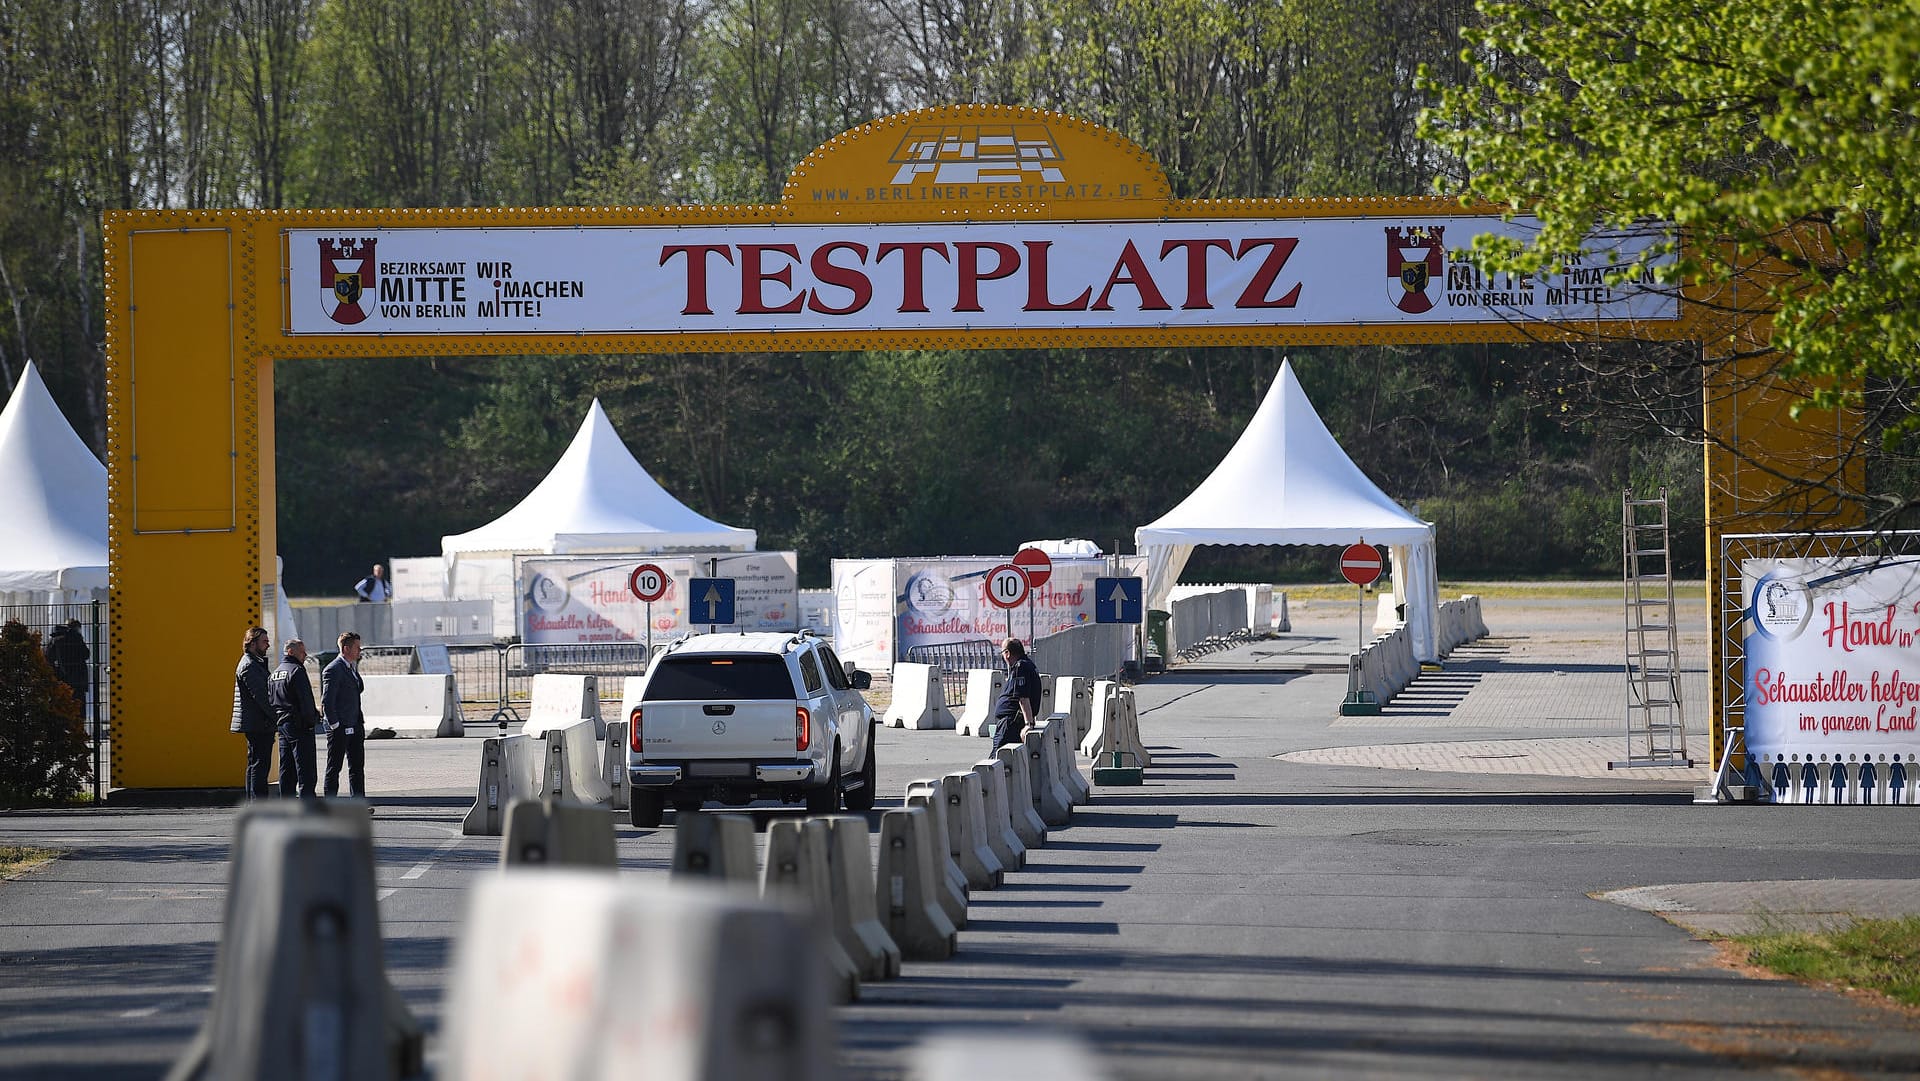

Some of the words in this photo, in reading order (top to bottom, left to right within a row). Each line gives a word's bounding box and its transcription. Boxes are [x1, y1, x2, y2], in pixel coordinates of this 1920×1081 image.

[812, 184, 1143, 200] WWW.BERLINER-FESTPLATZ.DE
[380, 262, 466, 275] BEZIRKSAMT
[477, 262, 512, 279] WIR
[659, 238, 1303, 315] TESTPLATZ
[380, 277, 466, 303] MITTE
[503, 281, 584, 298] MACHEN
[1447, 293, 1478, 307] VON
[1483, 292, 1534, 307] BERLIN
[380, 305, 411, 318] VON
[415, 304, 466, 318] BERLIN
[641, 576, 657, 590] 10
[997, 576, 1018, 597] 10
[1037, 580, 1085, 609] Hand
[903, 616, 972, 636] Schausteller
[974, 616, 1006, 636] helfen
[1823, 601, 1898, 653] Hand
[1899, 629, 1914, 648] in
[1755, 668, 1868, 706] Schausteller
[1799, 713, 1818, 731] im
[1822, 716, 1872, 736] ganzen
[1876, 704, 1918, 733] Land
